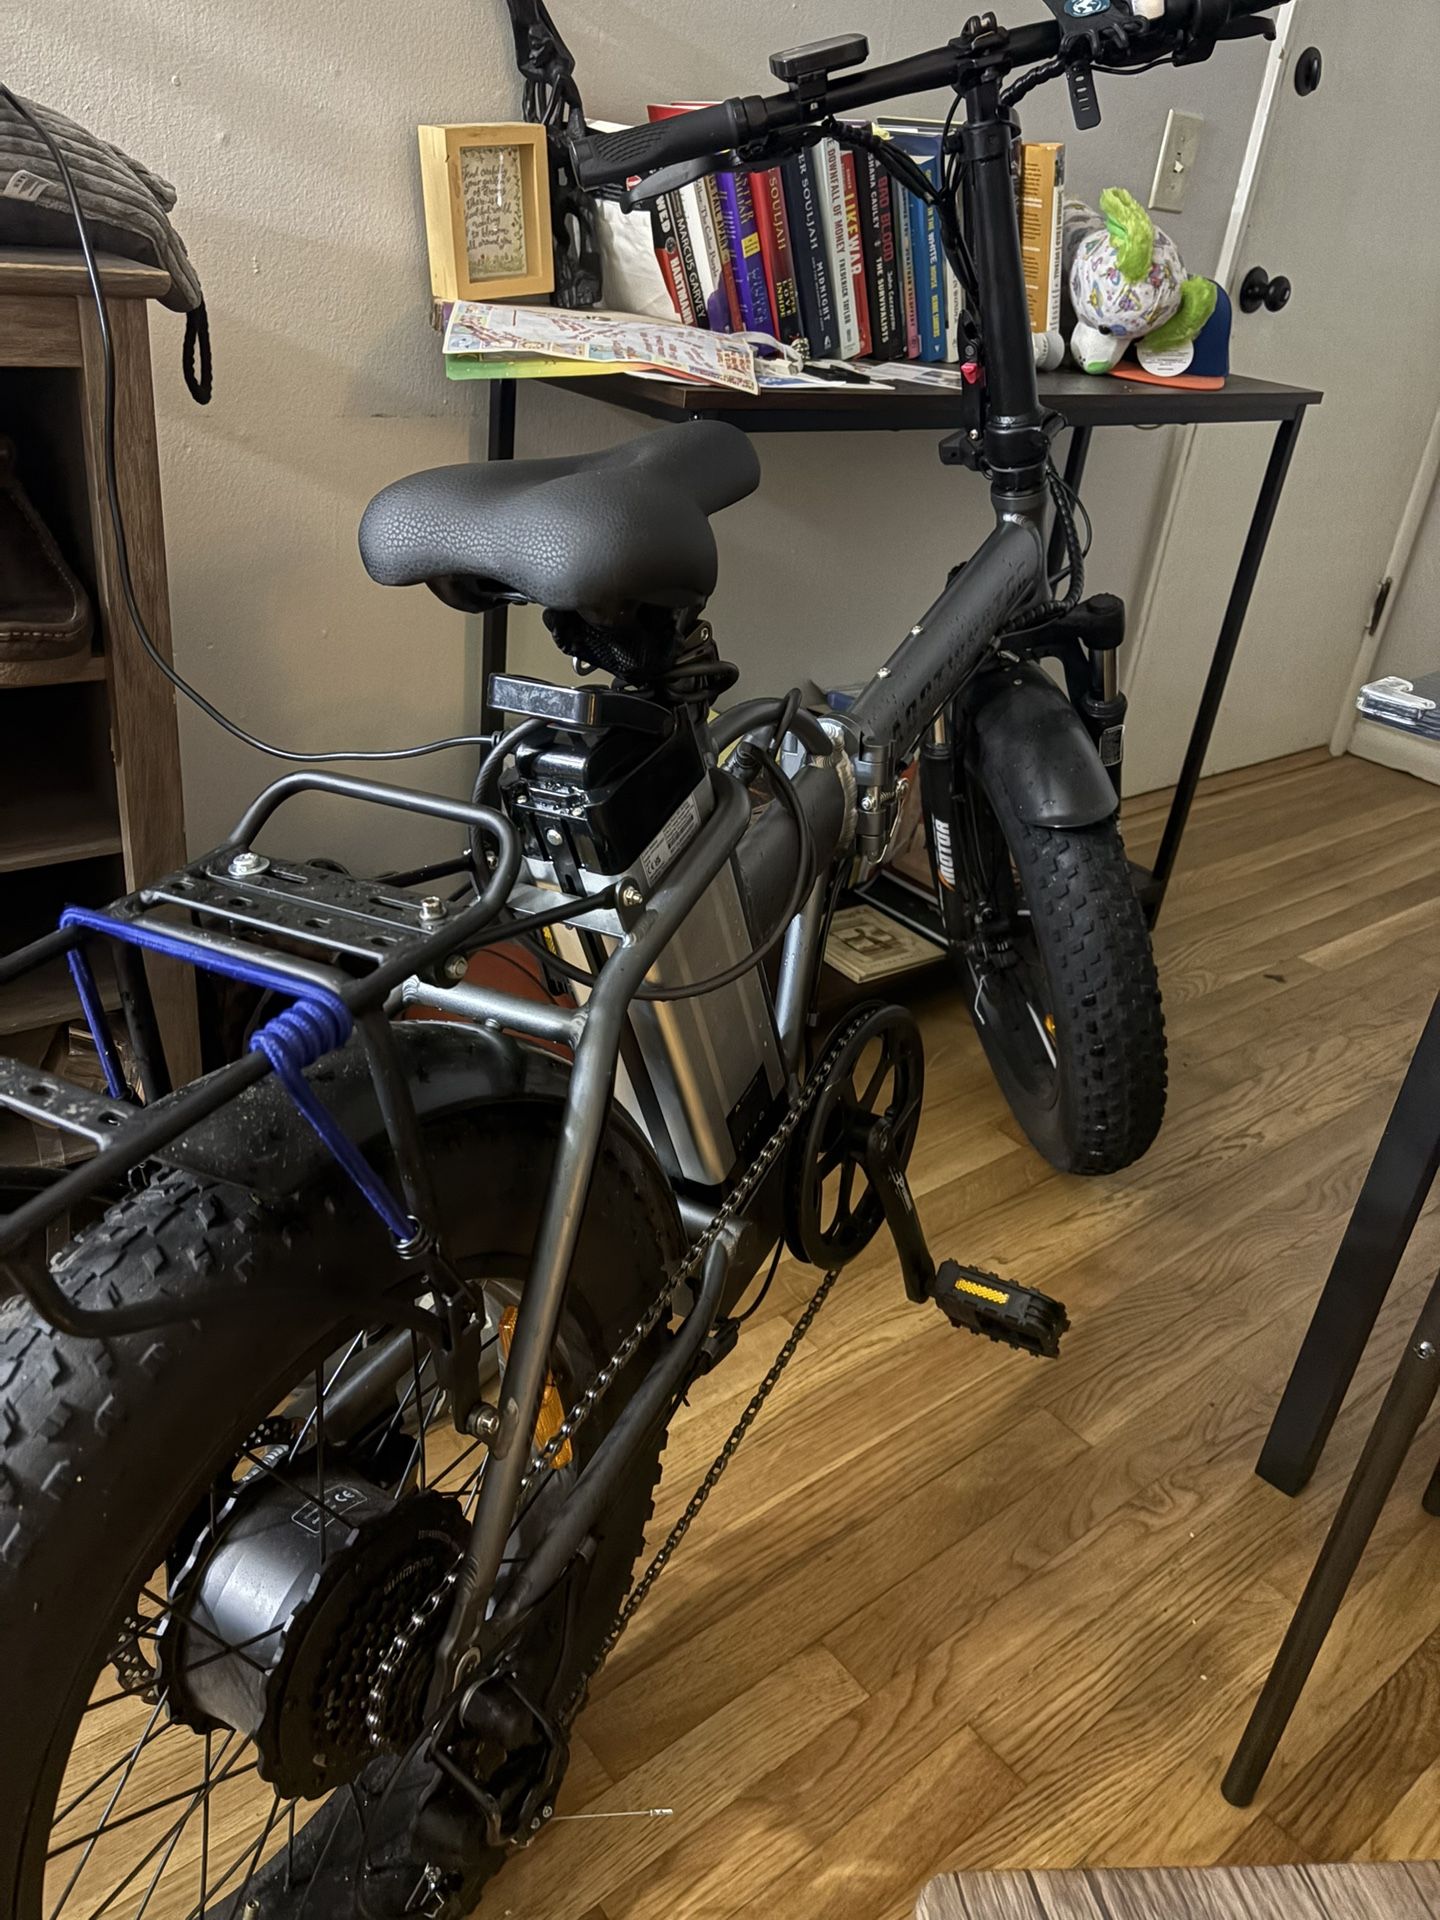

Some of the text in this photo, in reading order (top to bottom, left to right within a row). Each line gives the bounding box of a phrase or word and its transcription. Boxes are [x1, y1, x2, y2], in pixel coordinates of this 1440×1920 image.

[798, 154, 807, 175] ER
[828, 149, 841, 202] DOWNFALL
[769, 177, 787, 250] SOULJAH
[801, 180, 818, 250] SOULJAH
[833, 204, 843, 218] OF
[834, 220, 845, 254] MONEY
[867, 152, 889, 344] SHANA CAULEY THE SURVIVALISTS
[880, 212, 894, 262] BLOOD
[928, 231, 938, 265] WHITE
[670, 256, 694, 325] HARTMANN
[677, 218, 692, 271] MARCUS
[690, 272, 707, 318] GARVEY
[815, 260, 832, 321] MIDNIGHT
[839, 258, 849, 300] FREDERICK
[776, 281, 786, 317] INSIDE
[782, 280, 792, 315] LOVE
[935, 818, 956, 885] MOTOR
